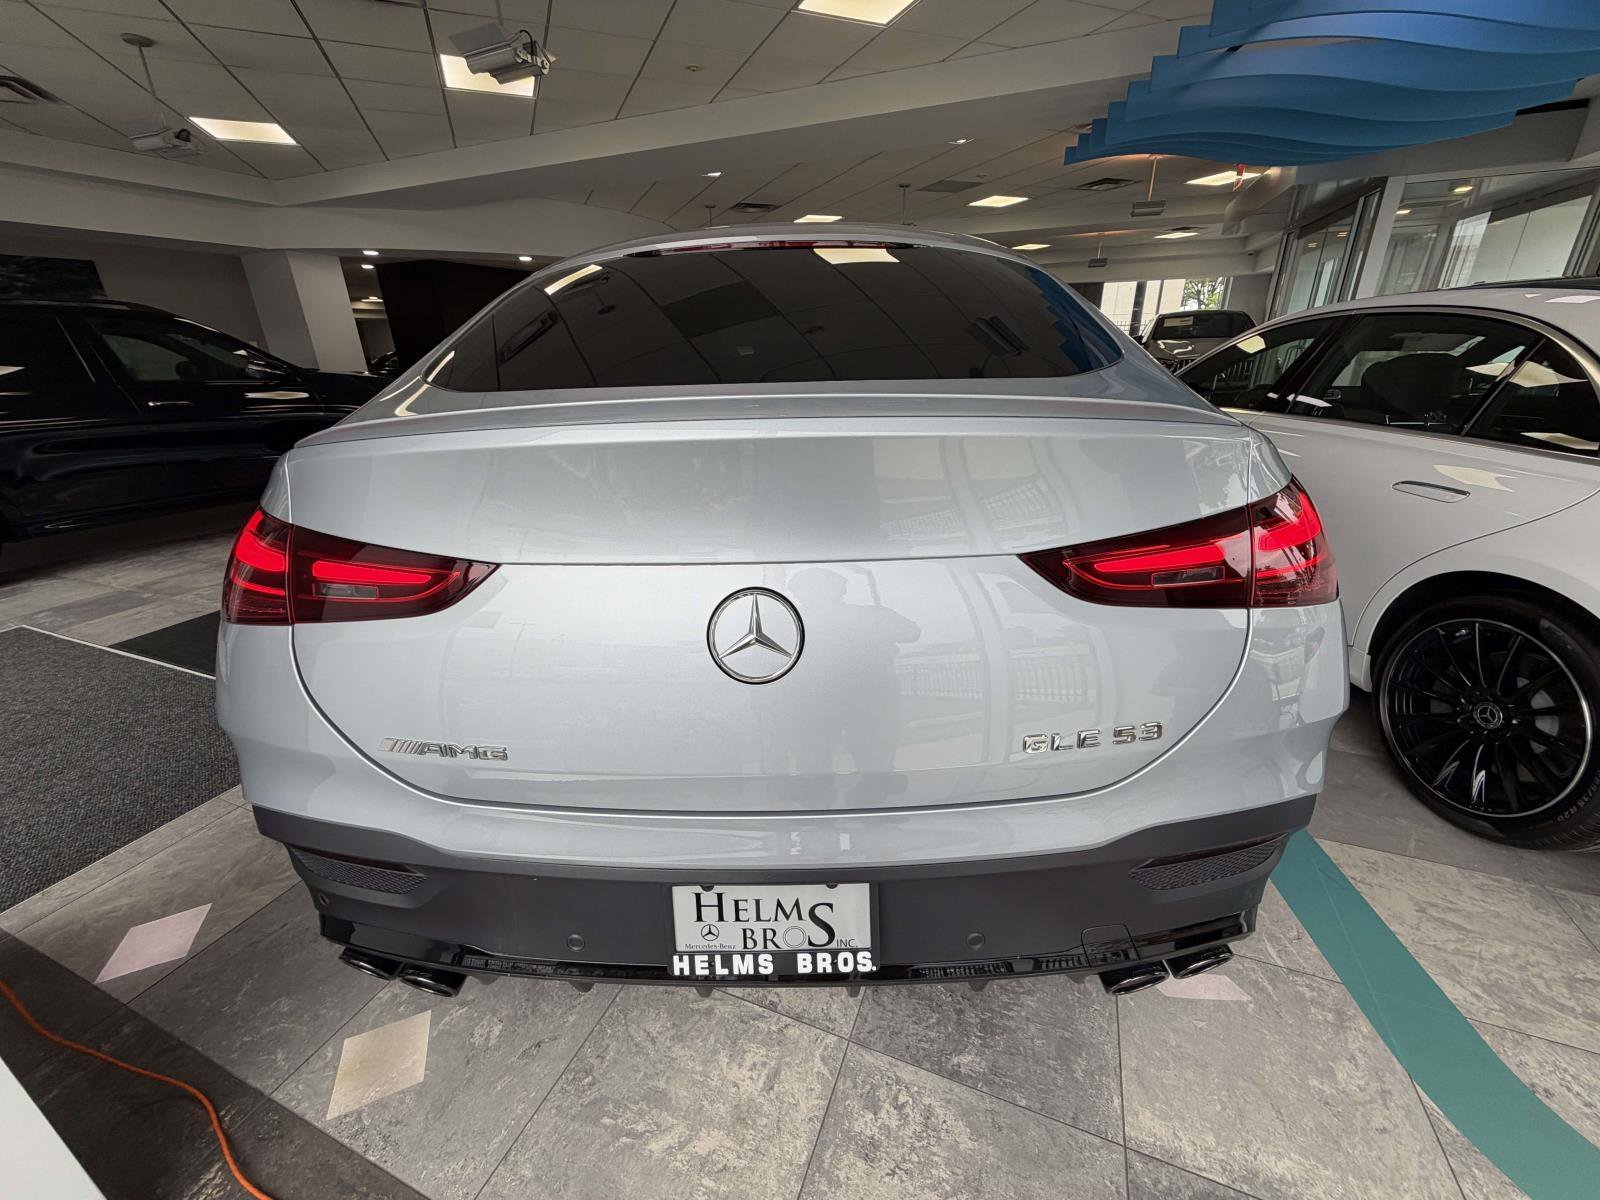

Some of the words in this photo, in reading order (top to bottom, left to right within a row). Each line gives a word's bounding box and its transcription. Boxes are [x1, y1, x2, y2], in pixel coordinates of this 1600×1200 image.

[1023, 729, 1101, 754] GLE
[1112, 721, 1163, 745] 53
[417, 741, 508, 761] AMG
[691, 892, 836, 948] HELMS
[836, 938, 858, 948] INC.
[672, 953, 774, 976] HELMS
[796, 951, 877, 975] BROS.
